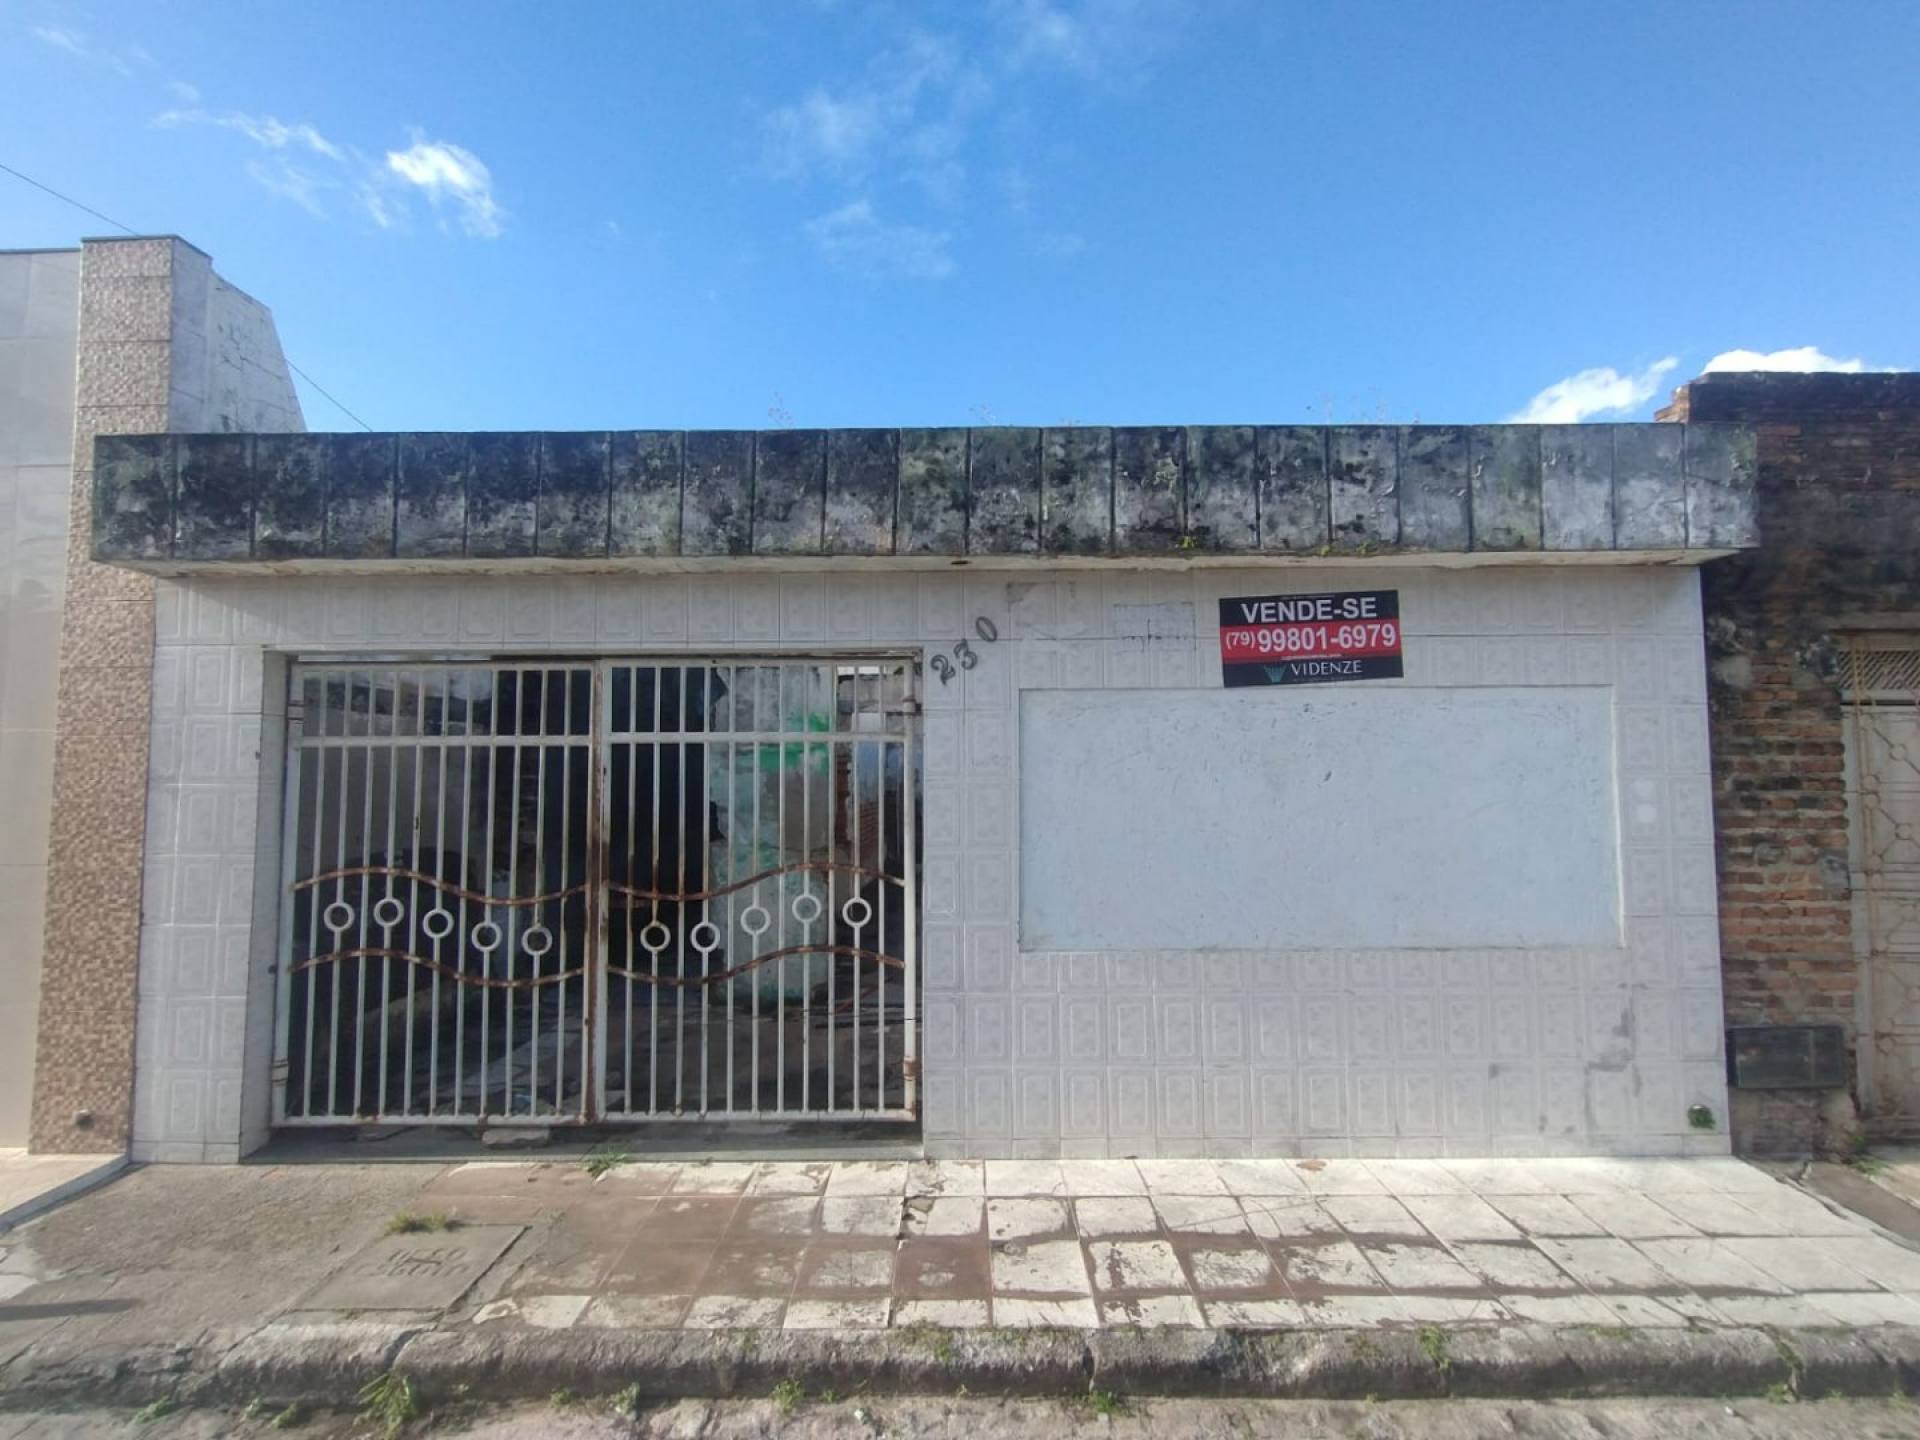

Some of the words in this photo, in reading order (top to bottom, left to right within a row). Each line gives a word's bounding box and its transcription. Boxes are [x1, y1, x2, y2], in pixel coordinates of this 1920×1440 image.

[1240, 597, 1377, 624] VENDE-SE
[930, 616, 998, 686] 230
[1226, 631, 1256, 650] (79)
[1257, 623, 1396, 653] 99801-6979
[1290, 660, 1363, 676] VIDENZE
